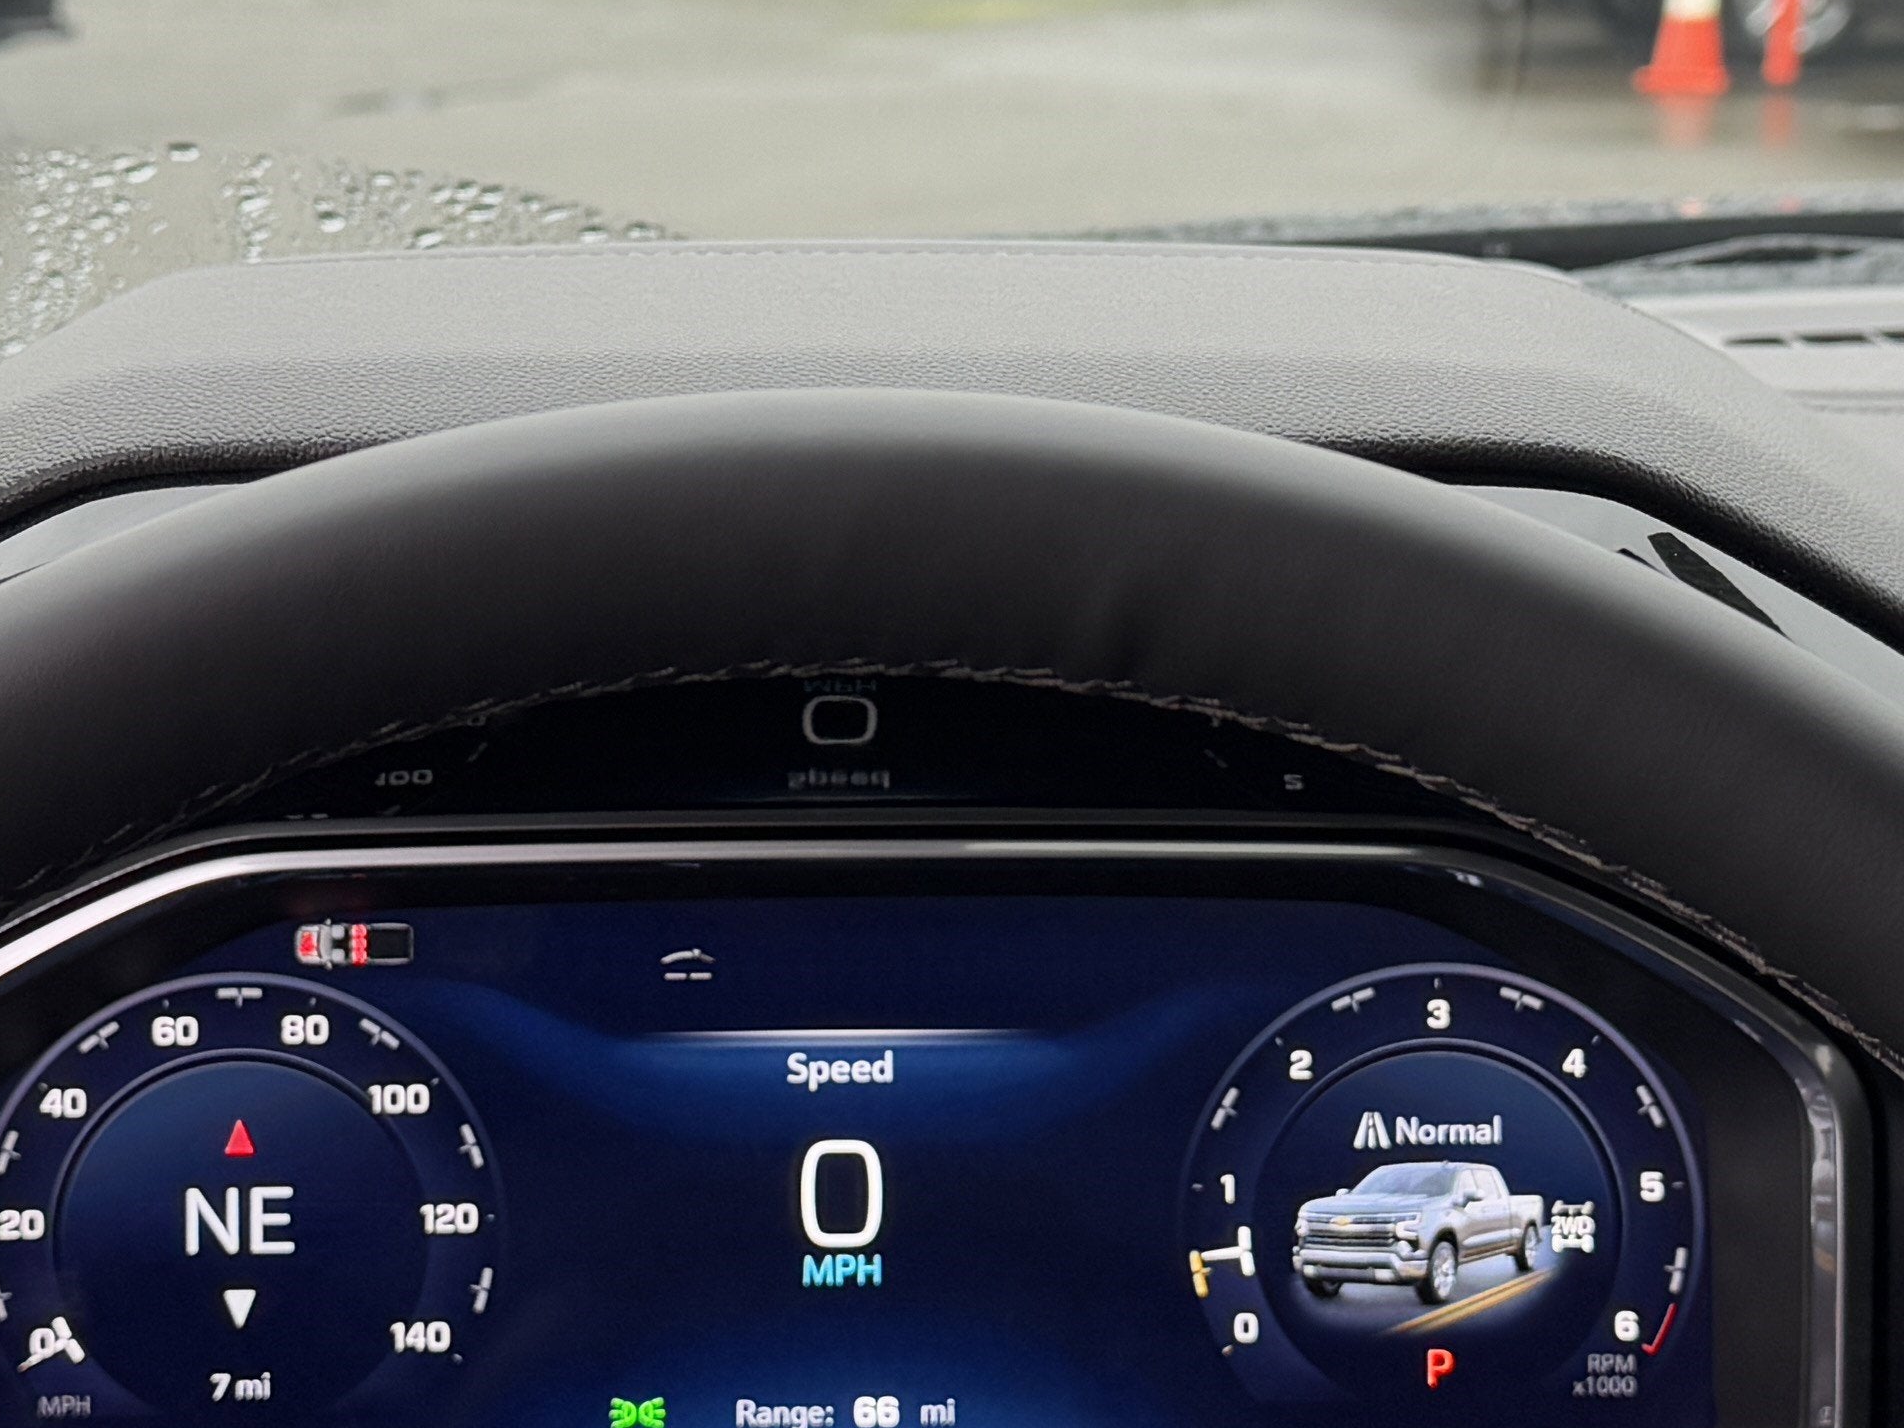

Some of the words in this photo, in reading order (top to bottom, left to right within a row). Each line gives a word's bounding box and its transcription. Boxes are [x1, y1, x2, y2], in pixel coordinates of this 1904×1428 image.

[280, 1014, 330, 1045] 80
[1426, 998, 1451, 1030] 3
[150, 1015, 199, 1047] 60
[786, 1049, 895, 1092] Speed
[1289, 1050, 1314, 1080] 2
[1561, 1049, 1587, 1079] 4
[39, 1086, 88, 1119] 40
[366, 1083, 430, 1115] 100
[1395, 1115, 1503, 1146] Normal
[799, 1138, 884, 1249] 0
[1220, 1174, 1236, 1205] 1
[1639, 1172, 1666, 1203] 5
[184, 1184, 296, 1257] NE
[419, 1202, 480, 1234] 120
[1550, 1215, 1596, 1236] 2WD
[801, 1254, 883, 1287] MPH
[28, 1326, 56, 1356] 0
[389, 1320, 451, 1353] 140
[1232, 1312, 1260, 1344] 0
[1613, 1311, 1640, 1342] 6
[1426, 1348, 1456, 1389] P
[1586, 1352, 1637, 1374] RPM
[209, 1372, 232, 1400] 7
[236, 1371, 272, 1400] mi
[1572, 1375, 1637, 1398] x1000
[37, 1394, 91, 1418] MPH
[852, 1395, 900, 1428] 66
[919, 1398, 956, 1428] mi
